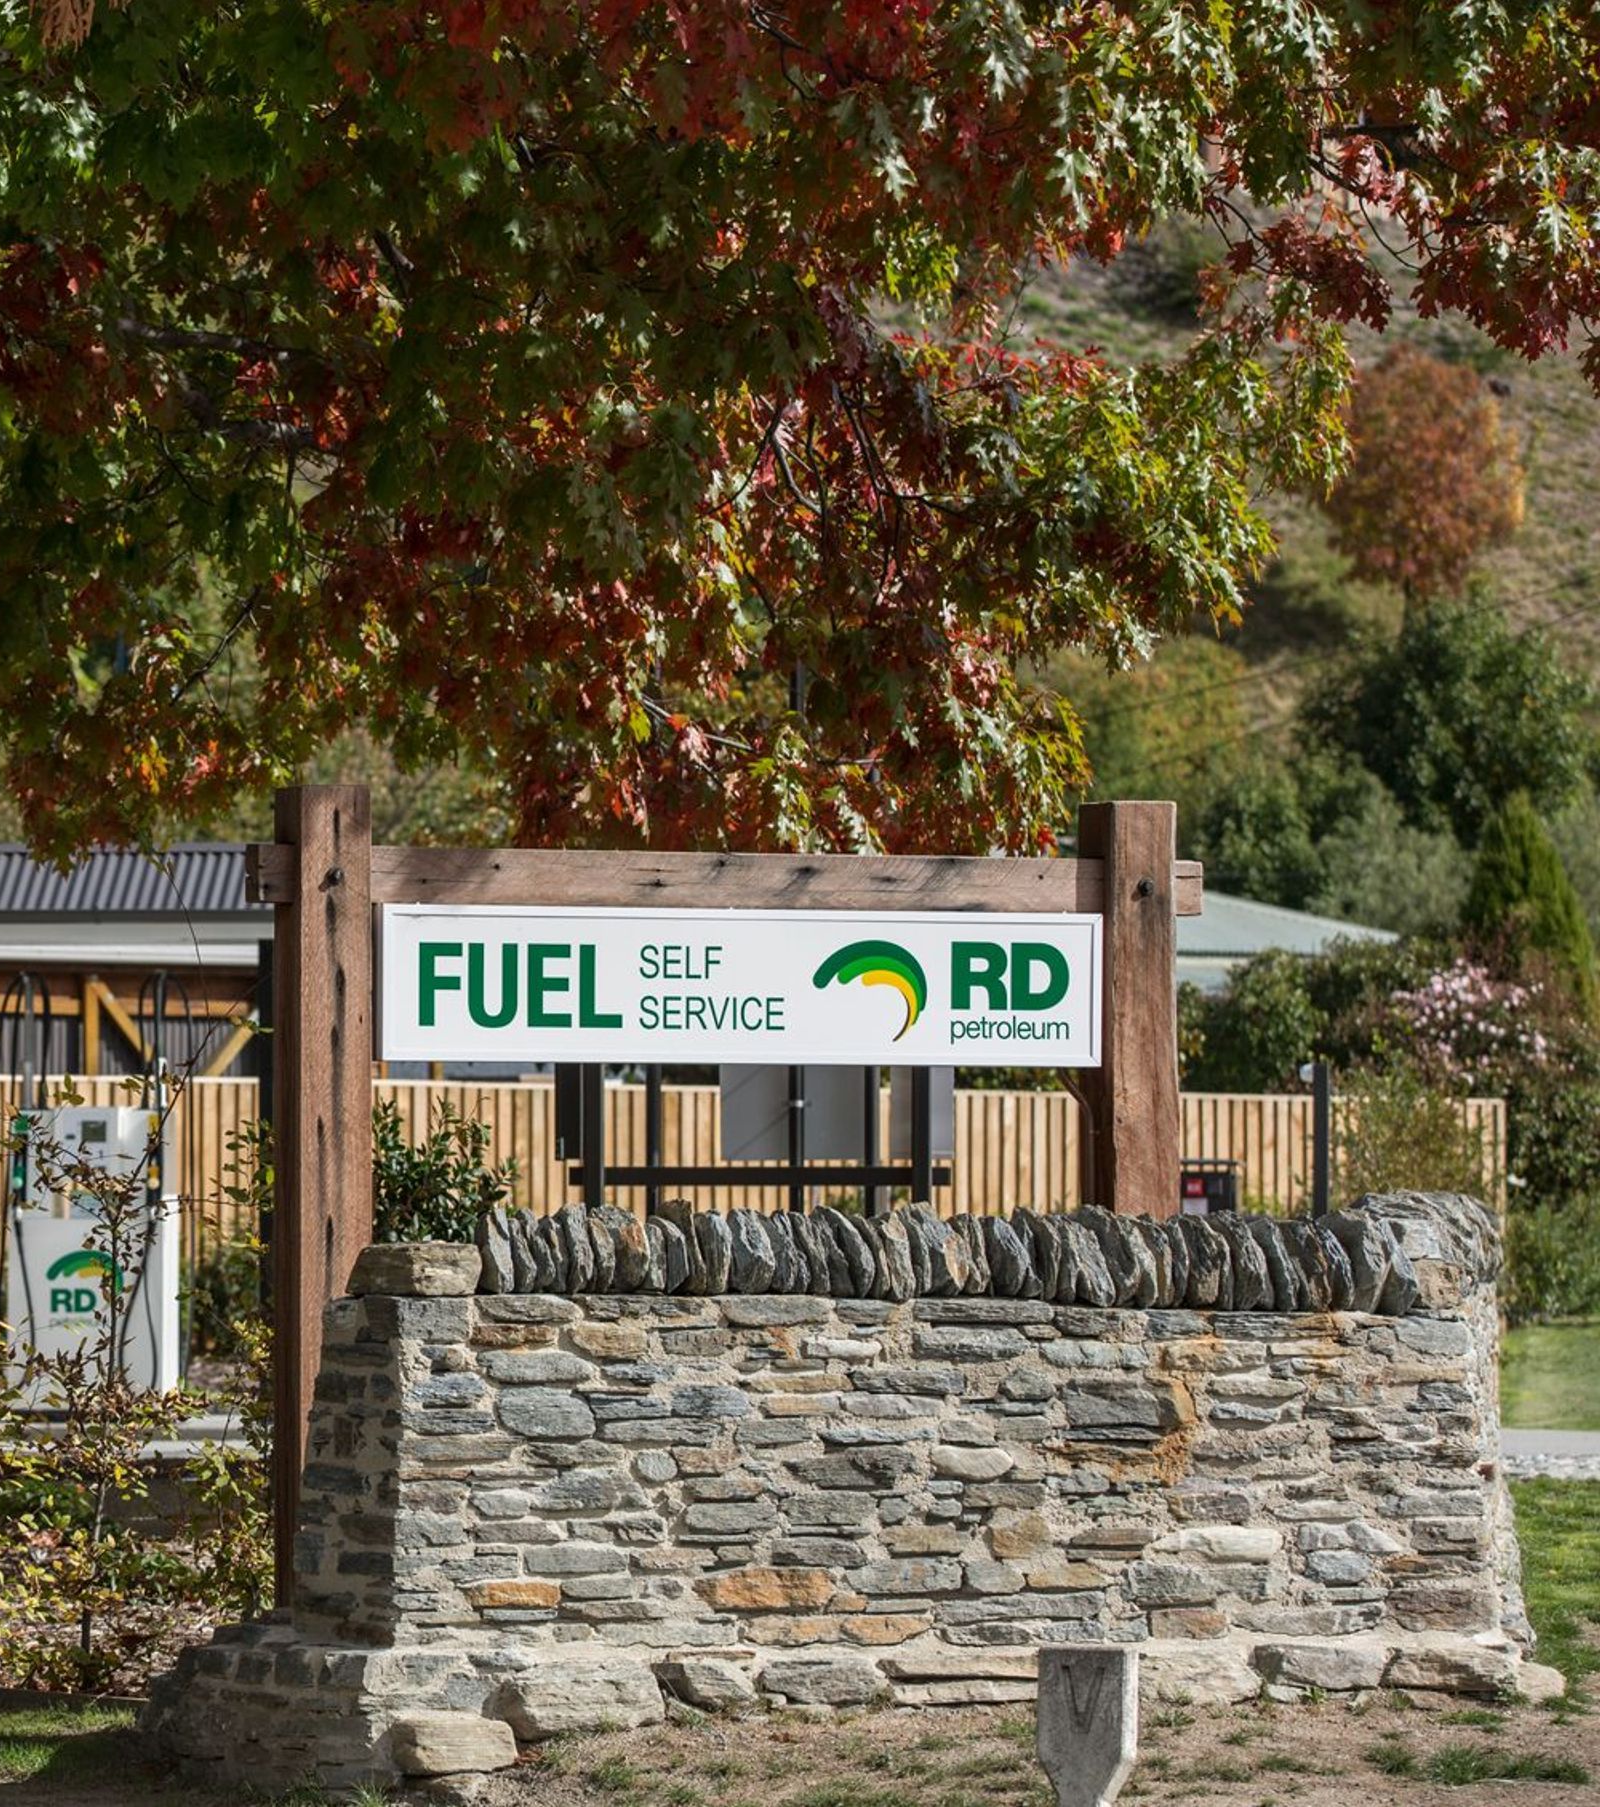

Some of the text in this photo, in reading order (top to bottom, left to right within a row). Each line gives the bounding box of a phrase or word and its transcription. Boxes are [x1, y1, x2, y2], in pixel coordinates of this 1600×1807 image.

[639, 944, 723, 980] SELF
[950, 941, 1071, 1012] RD
[418, 941, 624, 1030] FUEL
[639, 995, 786, 1032] SERVICE
[950, 1014, 1071, 1045] petroleum
[50, 1288, 97, 1313] RD
